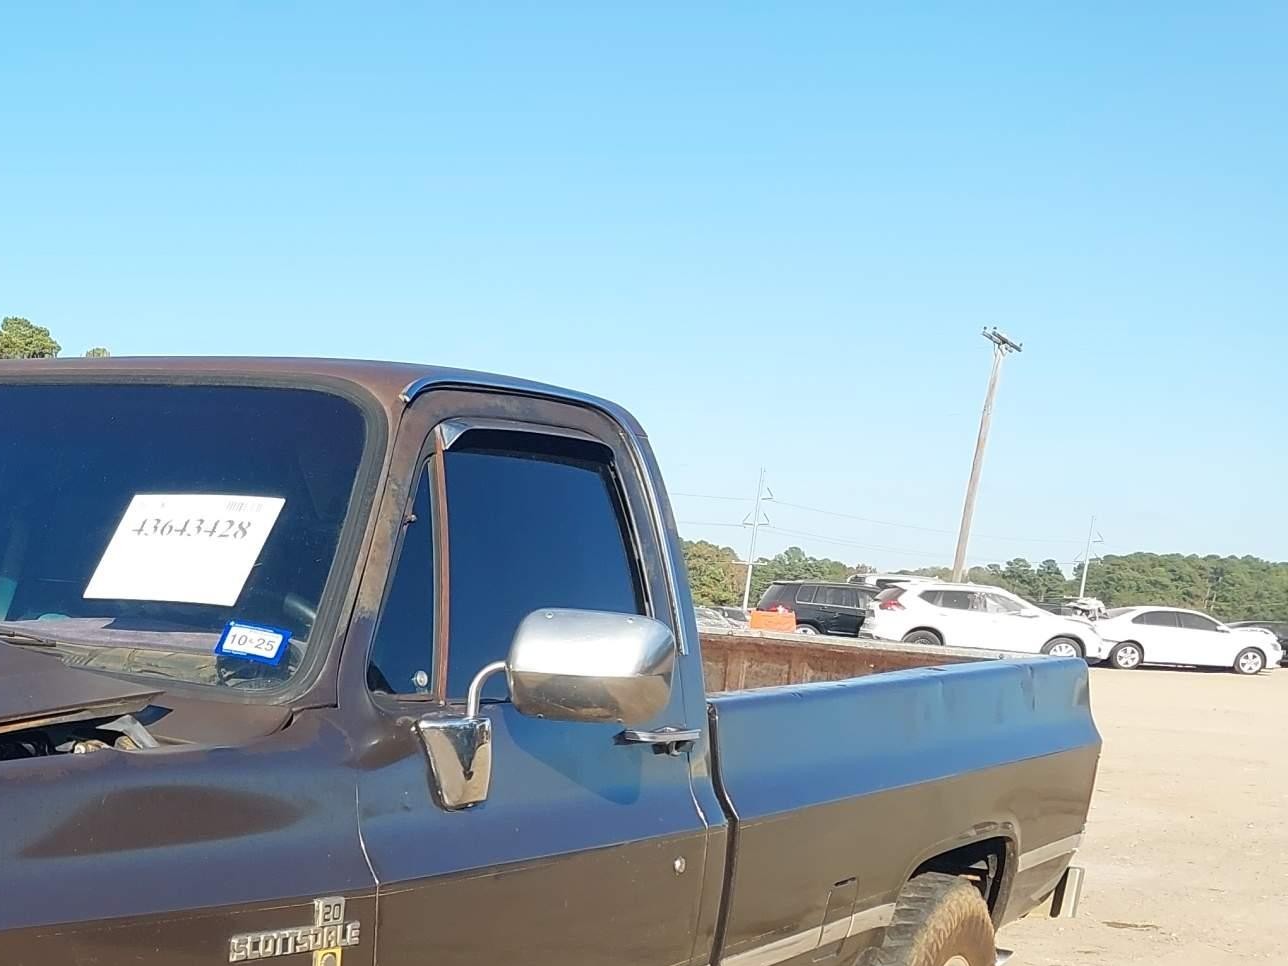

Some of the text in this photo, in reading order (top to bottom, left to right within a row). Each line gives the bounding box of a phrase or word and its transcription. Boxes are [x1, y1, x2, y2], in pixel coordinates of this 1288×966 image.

[132, 518, 251, 539] 43643428
[323, 903, 342, 922] 20
[228, 920, 360, 962] SCOTTSDALE
